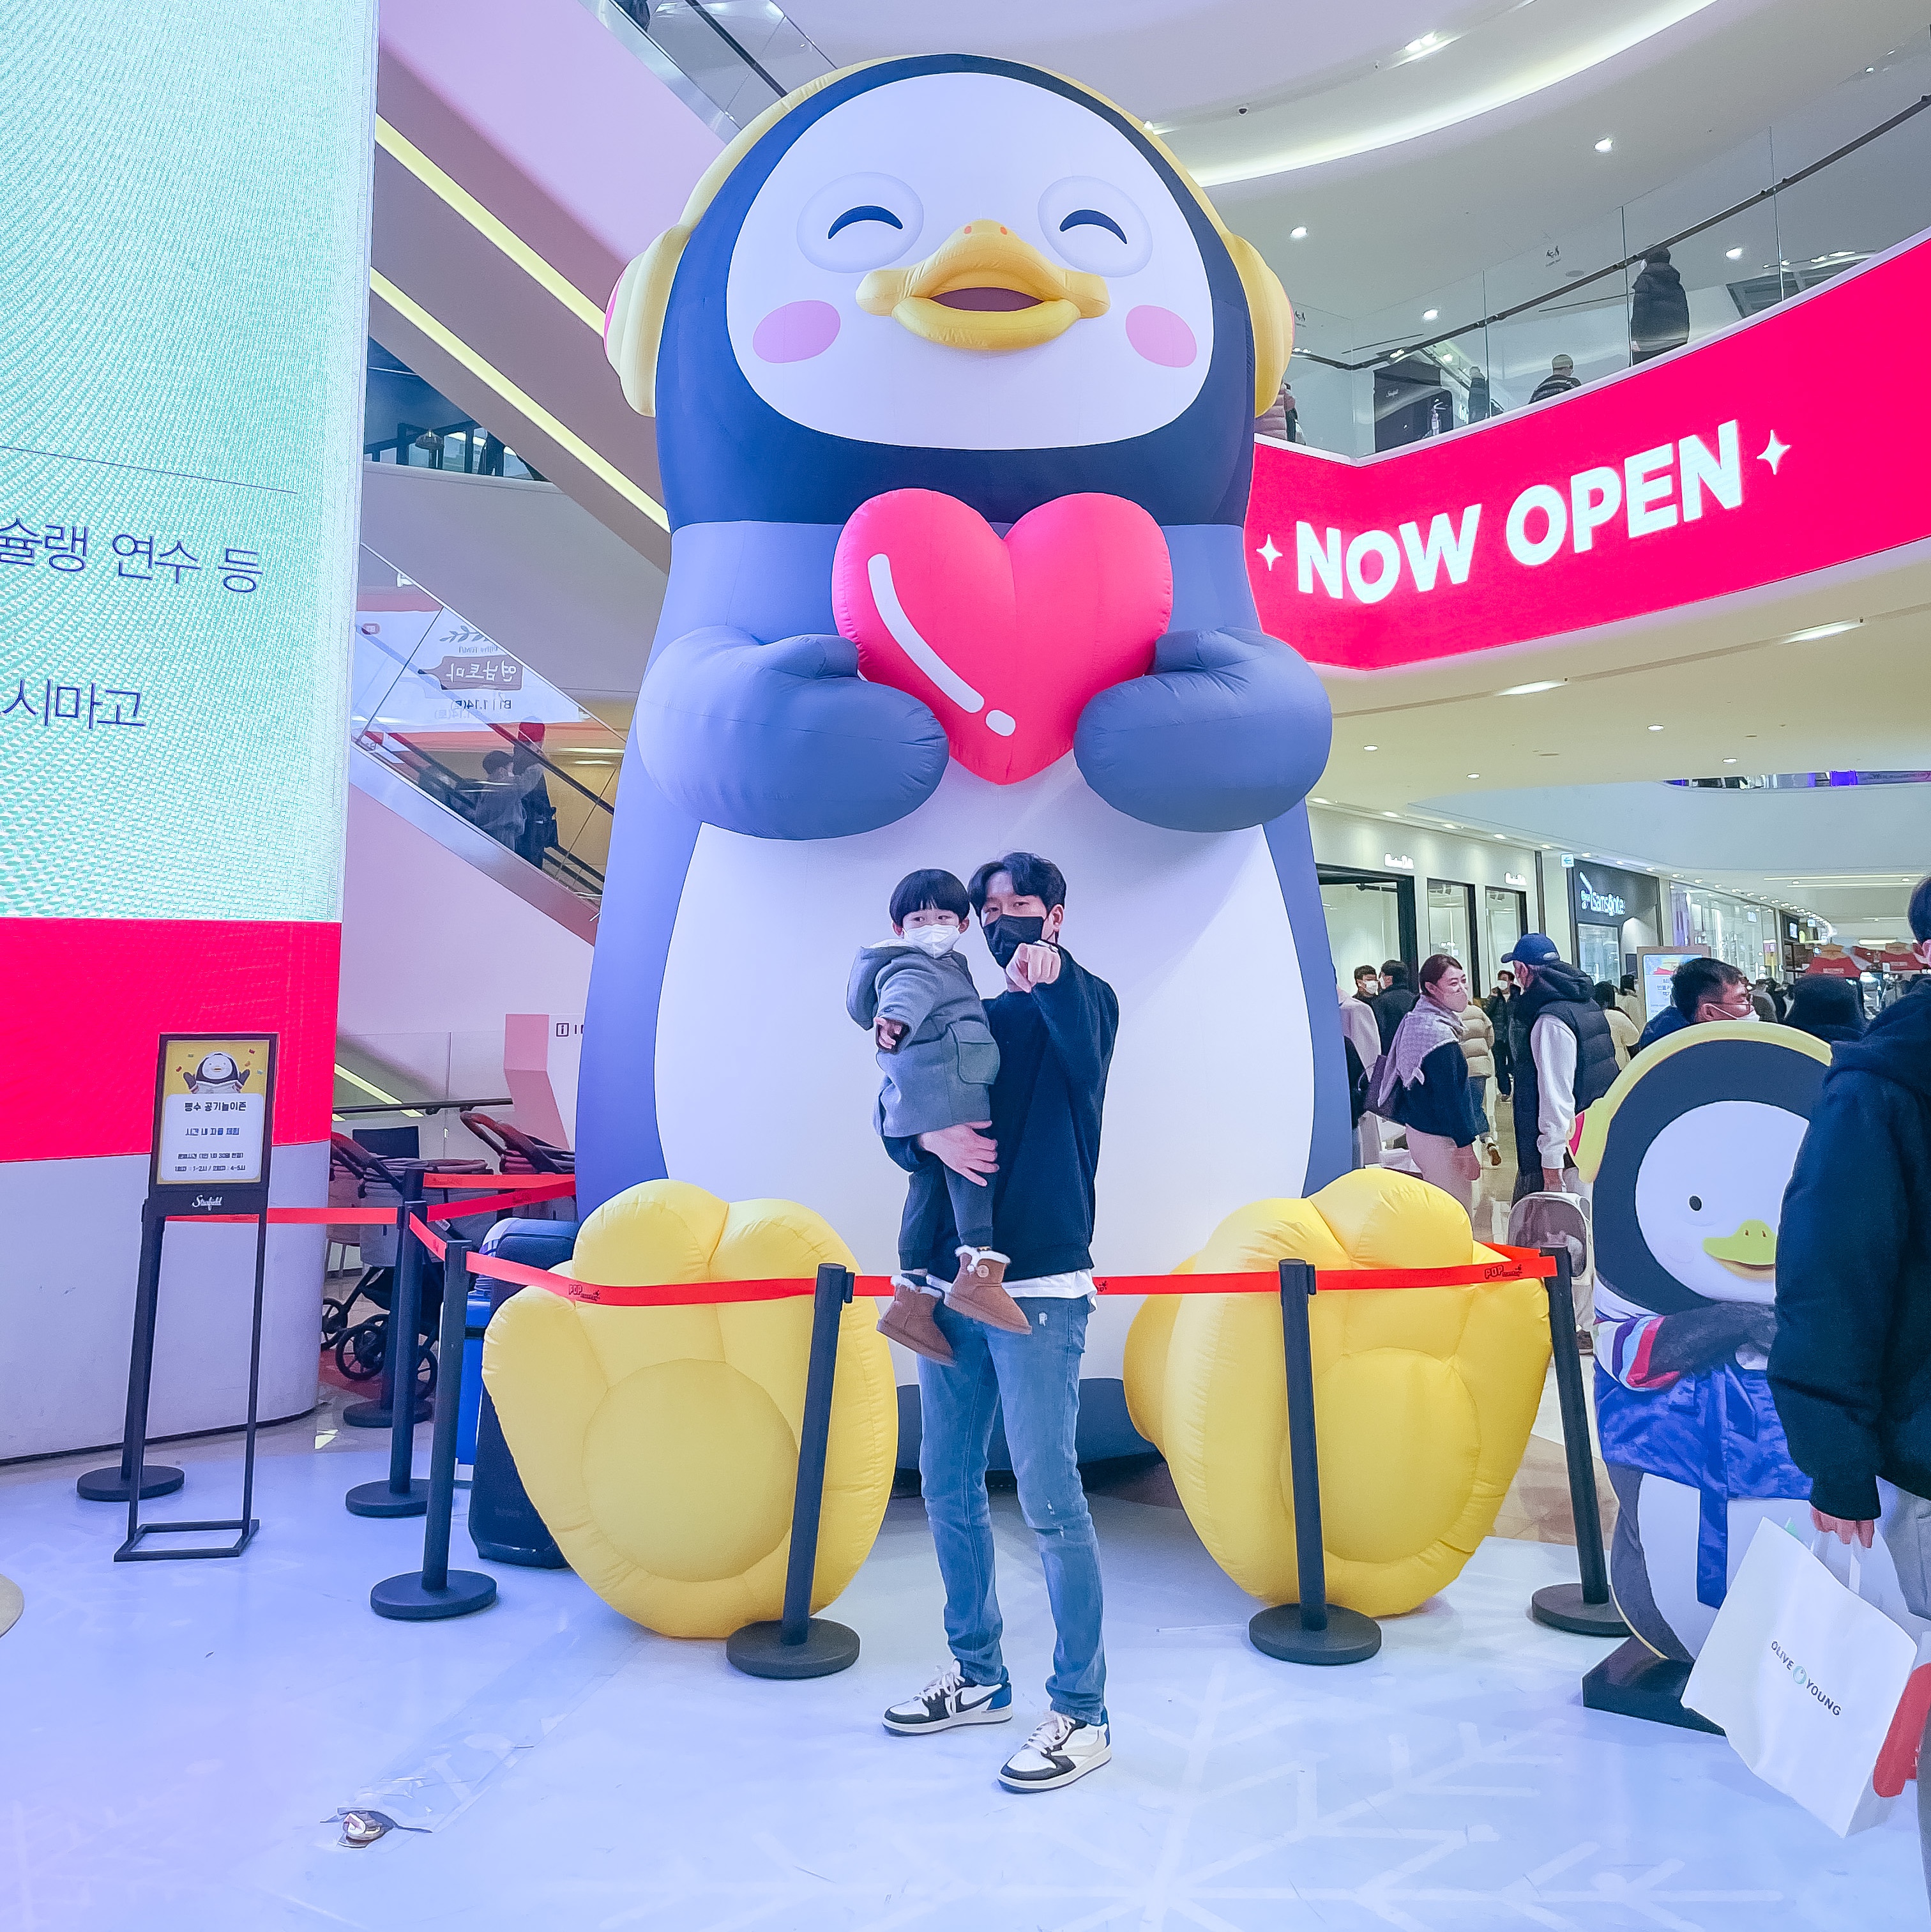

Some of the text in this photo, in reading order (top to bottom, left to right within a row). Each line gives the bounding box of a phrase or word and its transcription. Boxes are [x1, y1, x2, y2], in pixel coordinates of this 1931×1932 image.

[1296, 419, 1743, 604] NOW OPEN
[112, 533, 202, 584] 연수
[217, 547, 264, 593] 등
[1, 678, 146, 729] 시마고
[1484, 1264, 1504, 1280] POP
[1771, 1641, 1842, 1716] OLIVE YOUNG
